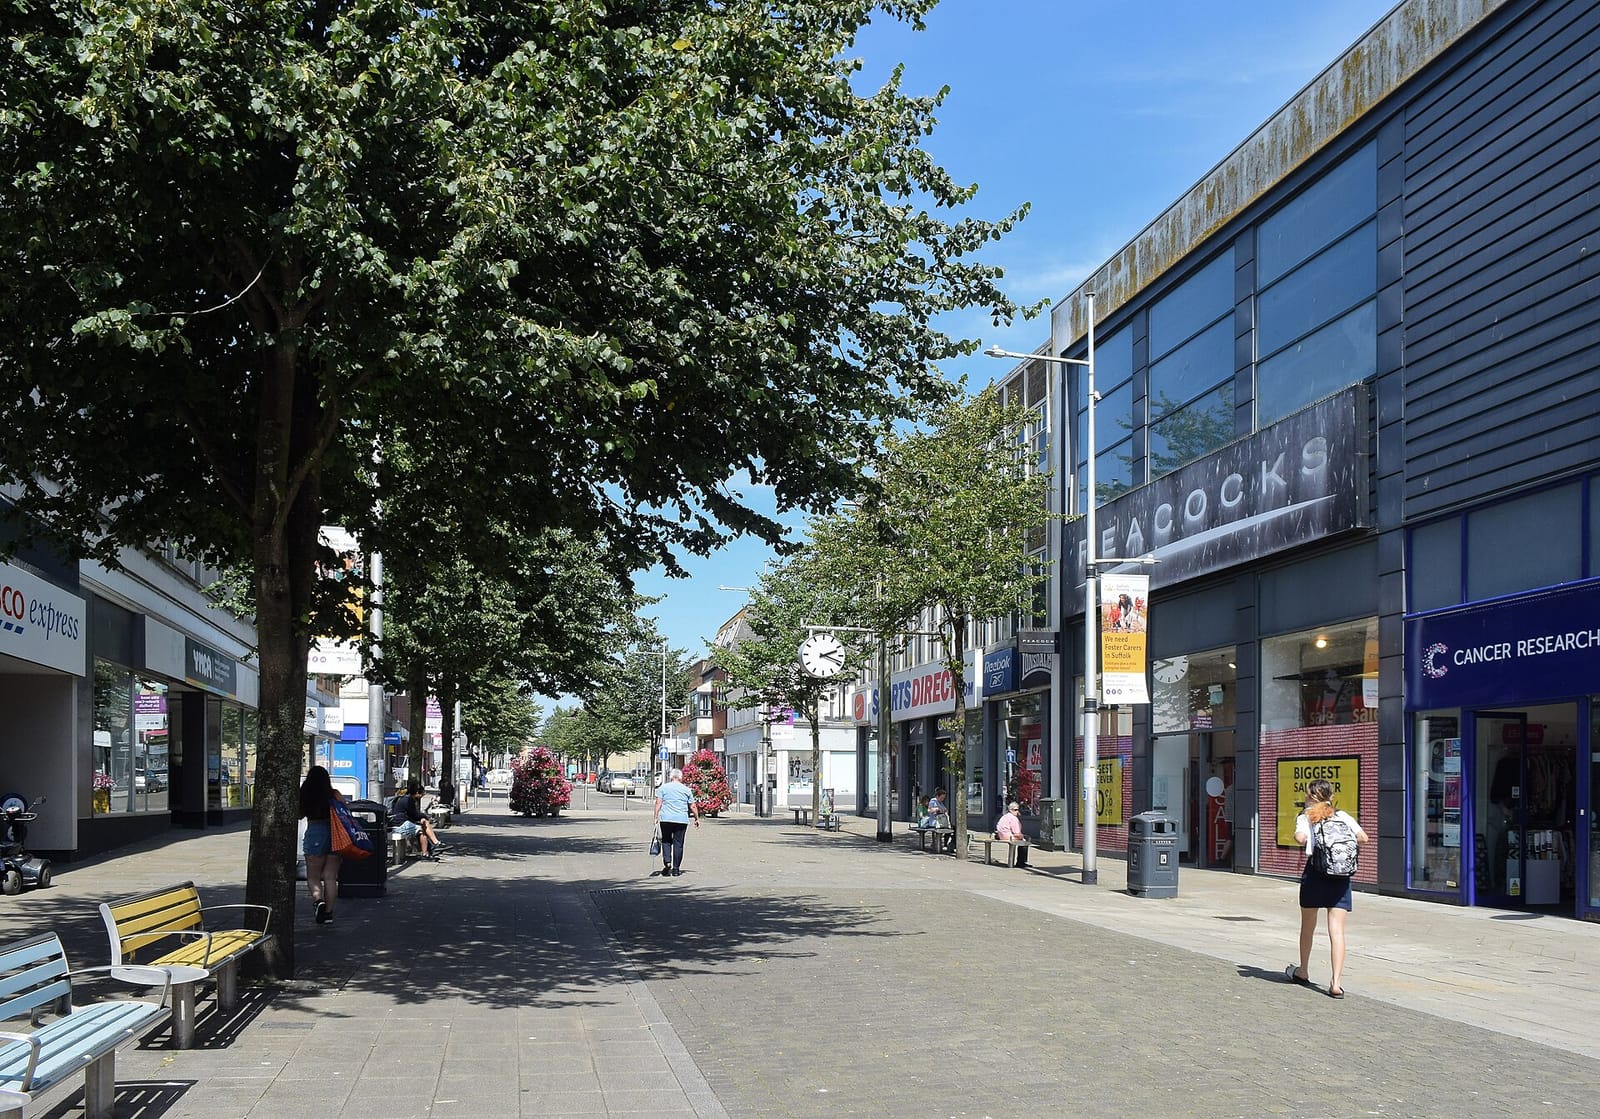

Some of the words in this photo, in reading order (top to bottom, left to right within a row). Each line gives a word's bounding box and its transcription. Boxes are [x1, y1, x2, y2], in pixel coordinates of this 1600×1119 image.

[0, 584, 24, 619] CO
[29, 599, 78, 640] express
[1453, 642, 1512, 666] CANCER
[1517, 628, 1600, 657] RESEARCH
[984, 656, 1011, 674] Reebok
[1096, 763, 1112, 774] GEST
[1294, 766, 1341, 779] BIGGEST
